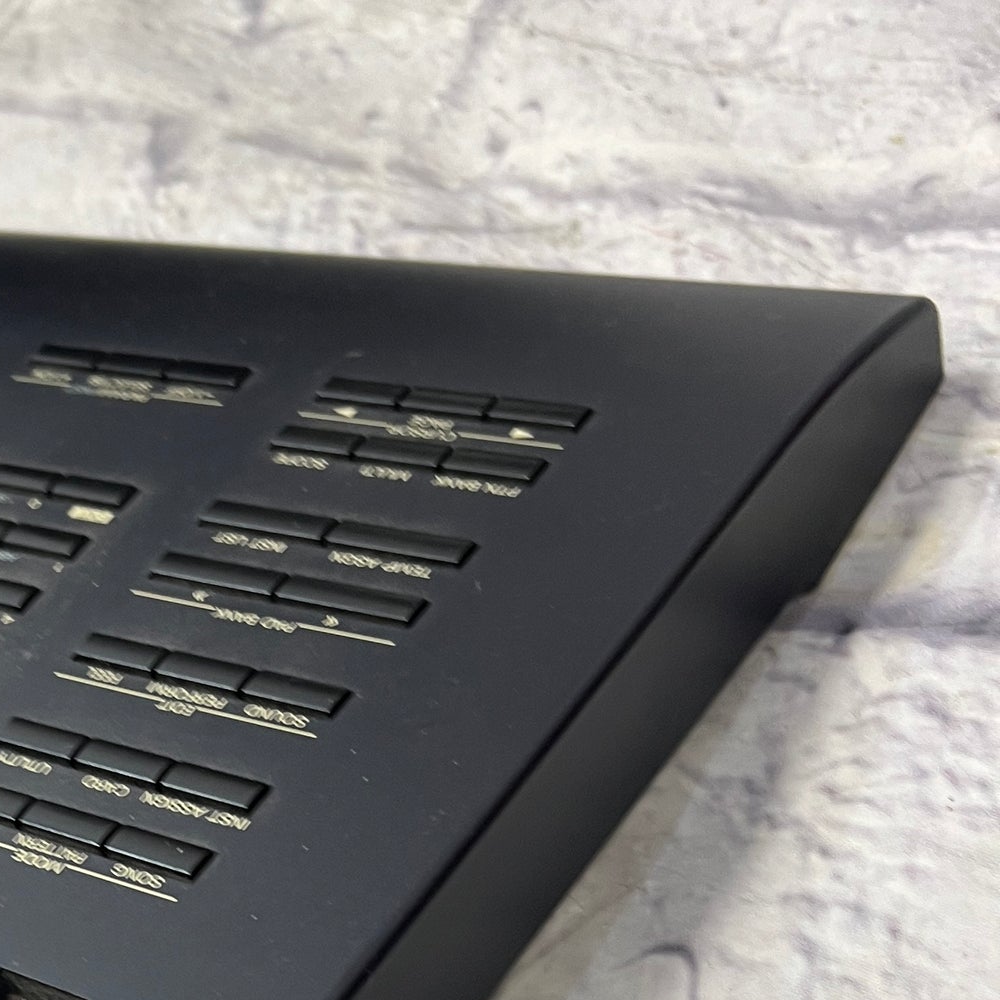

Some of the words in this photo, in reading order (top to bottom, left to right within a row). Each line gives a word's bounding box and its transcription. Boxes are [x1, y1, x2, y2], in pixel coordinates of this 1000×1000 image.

[145, 680, 229, 709] PERFORM
[243, 703, 310, 728] SOUND
[80, 774, 131, 797] CARD
[138, 790, 210, 818] ASSIGN
[204, 809, 252, 831] INST
[10, 847, 69, 874] MODE
[11, 832, 89, 864] PATTERN
[109, 862, 167, 889] SONG
